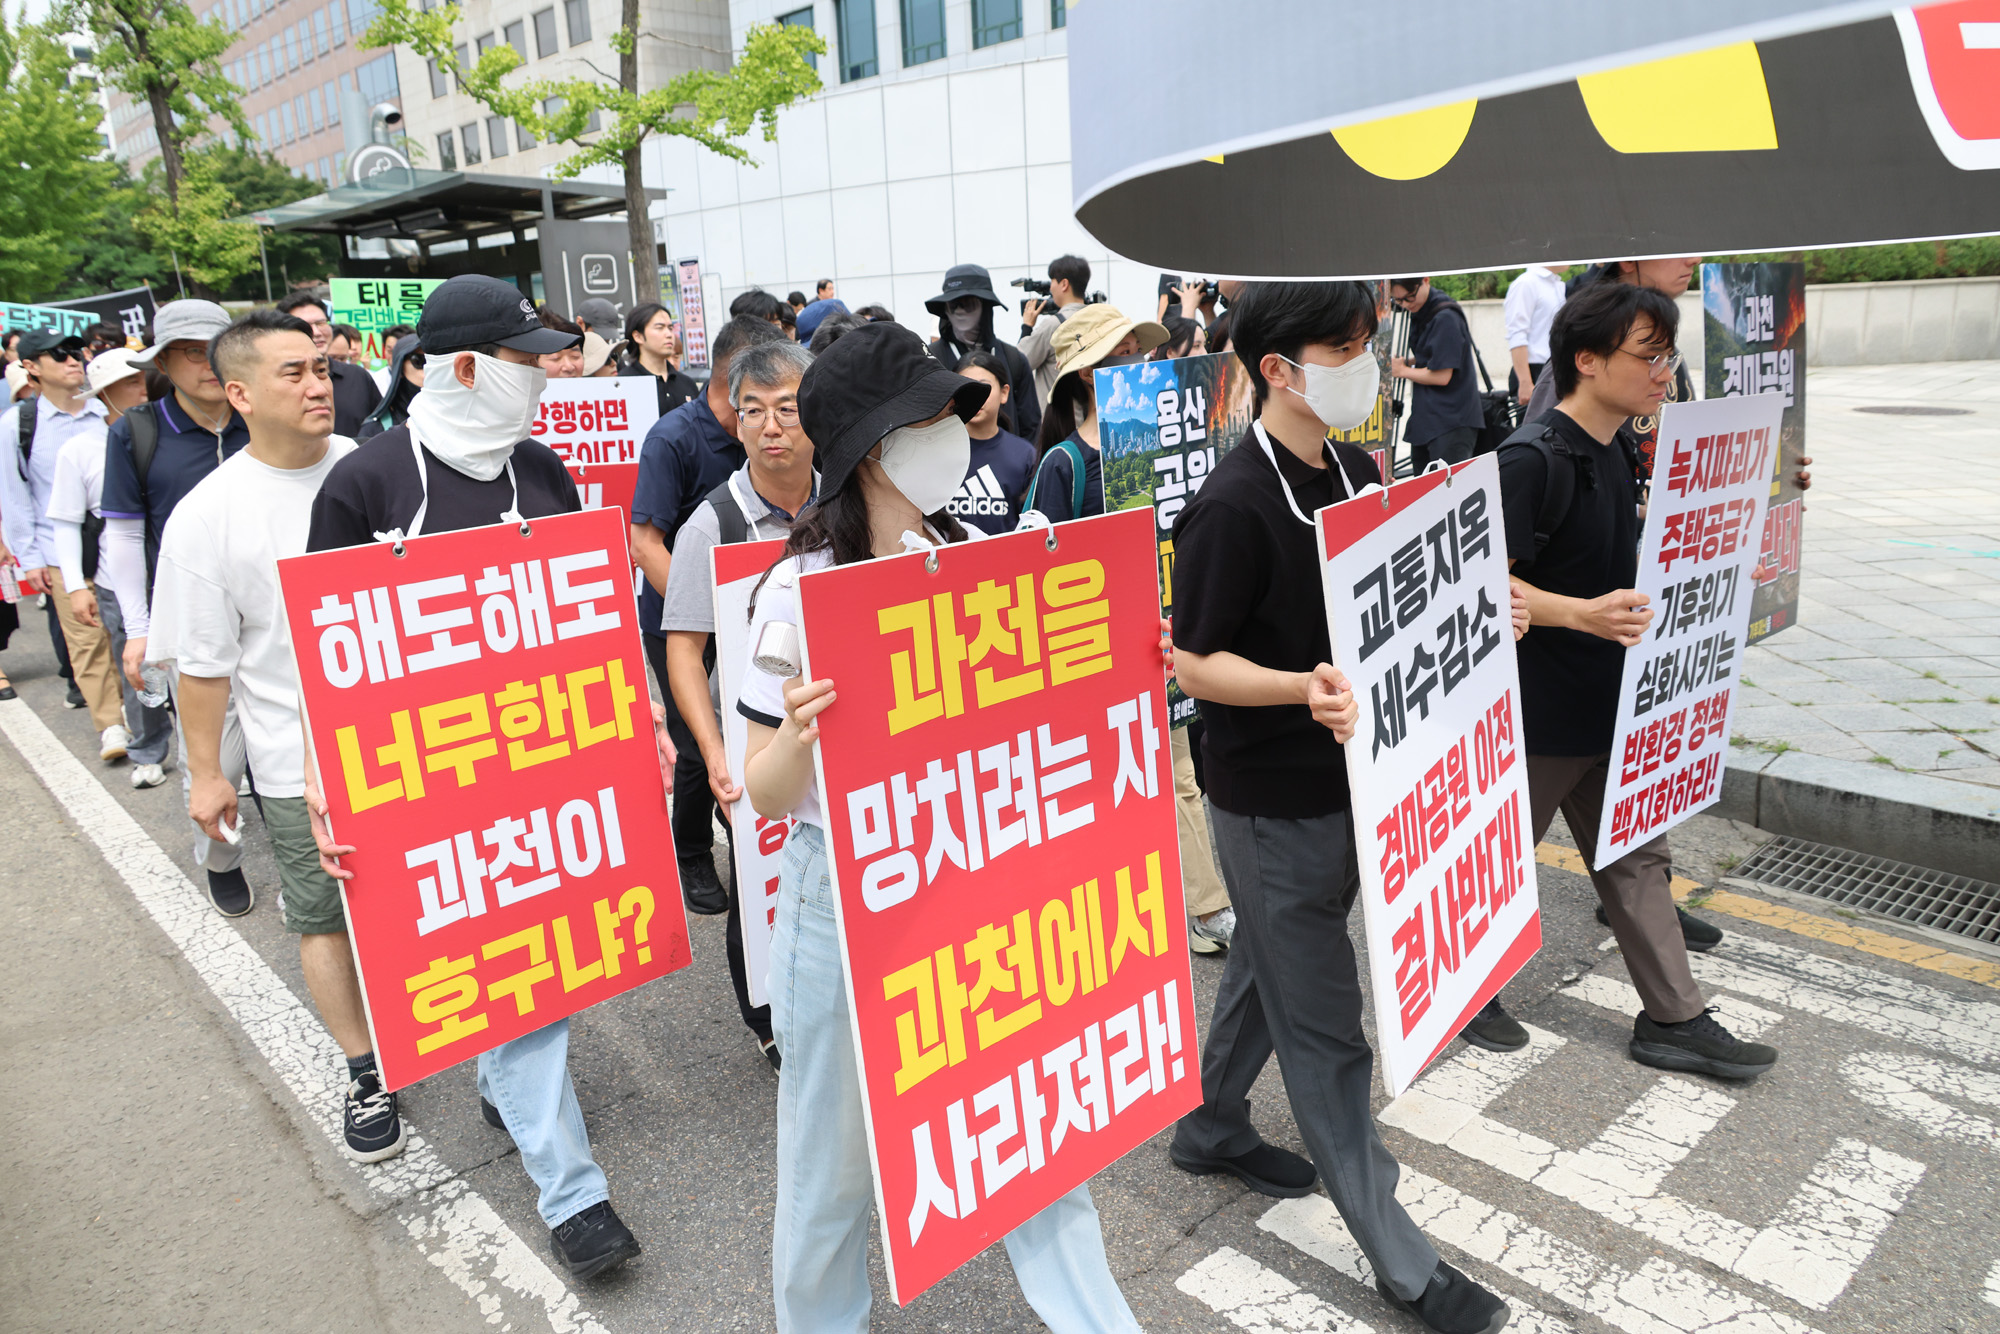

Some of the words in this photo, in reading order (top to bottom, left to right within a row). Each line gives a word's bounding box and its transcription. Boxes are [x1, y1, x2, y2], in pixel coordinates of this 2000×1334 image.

[1745, 294, 1775, 343] 과천
[1156, 385, 1206, 448] 용산
[1667, 426, 1771, 498] 녹지파괴가
[945, 497, 1009, 516] adidas
[1353, 487, 1491, 663] 교통지옥
[1658, 497, 1756, 573] 주택공급?
[311, 549, 621, 689] 해도해도
[877, 559, 1113, 736] 과천을
[1371, 585, 1501, 764] 세수감소
[1634, 630, 1736, 717] 심화시키는
[1655, 564, 1740, 641] 기후위기
[335, 658, 636, 814] 너무한다
[846, 723, 1095, 912] 망치려는
[1106, 690, 1160, 809] 자
[1376, 735, 1472, 905] 경마공원
[1474, 688, 1516, 795] 이전
[1610, 751, 1720, 847] 백지화하라!
[1620, 707, 1688, 787] 반환경
[1688, 688, 1730, 751] 정책
[405, 786, 626, 937] 과천이
[1392, 788, 1524, 1041] 결사반대!
[405, 885, 656, 1056] 호구냐?
[882, 850, 1169, 1096] 과천에서
[908, 978, 1186, 1248] 사라져라!
